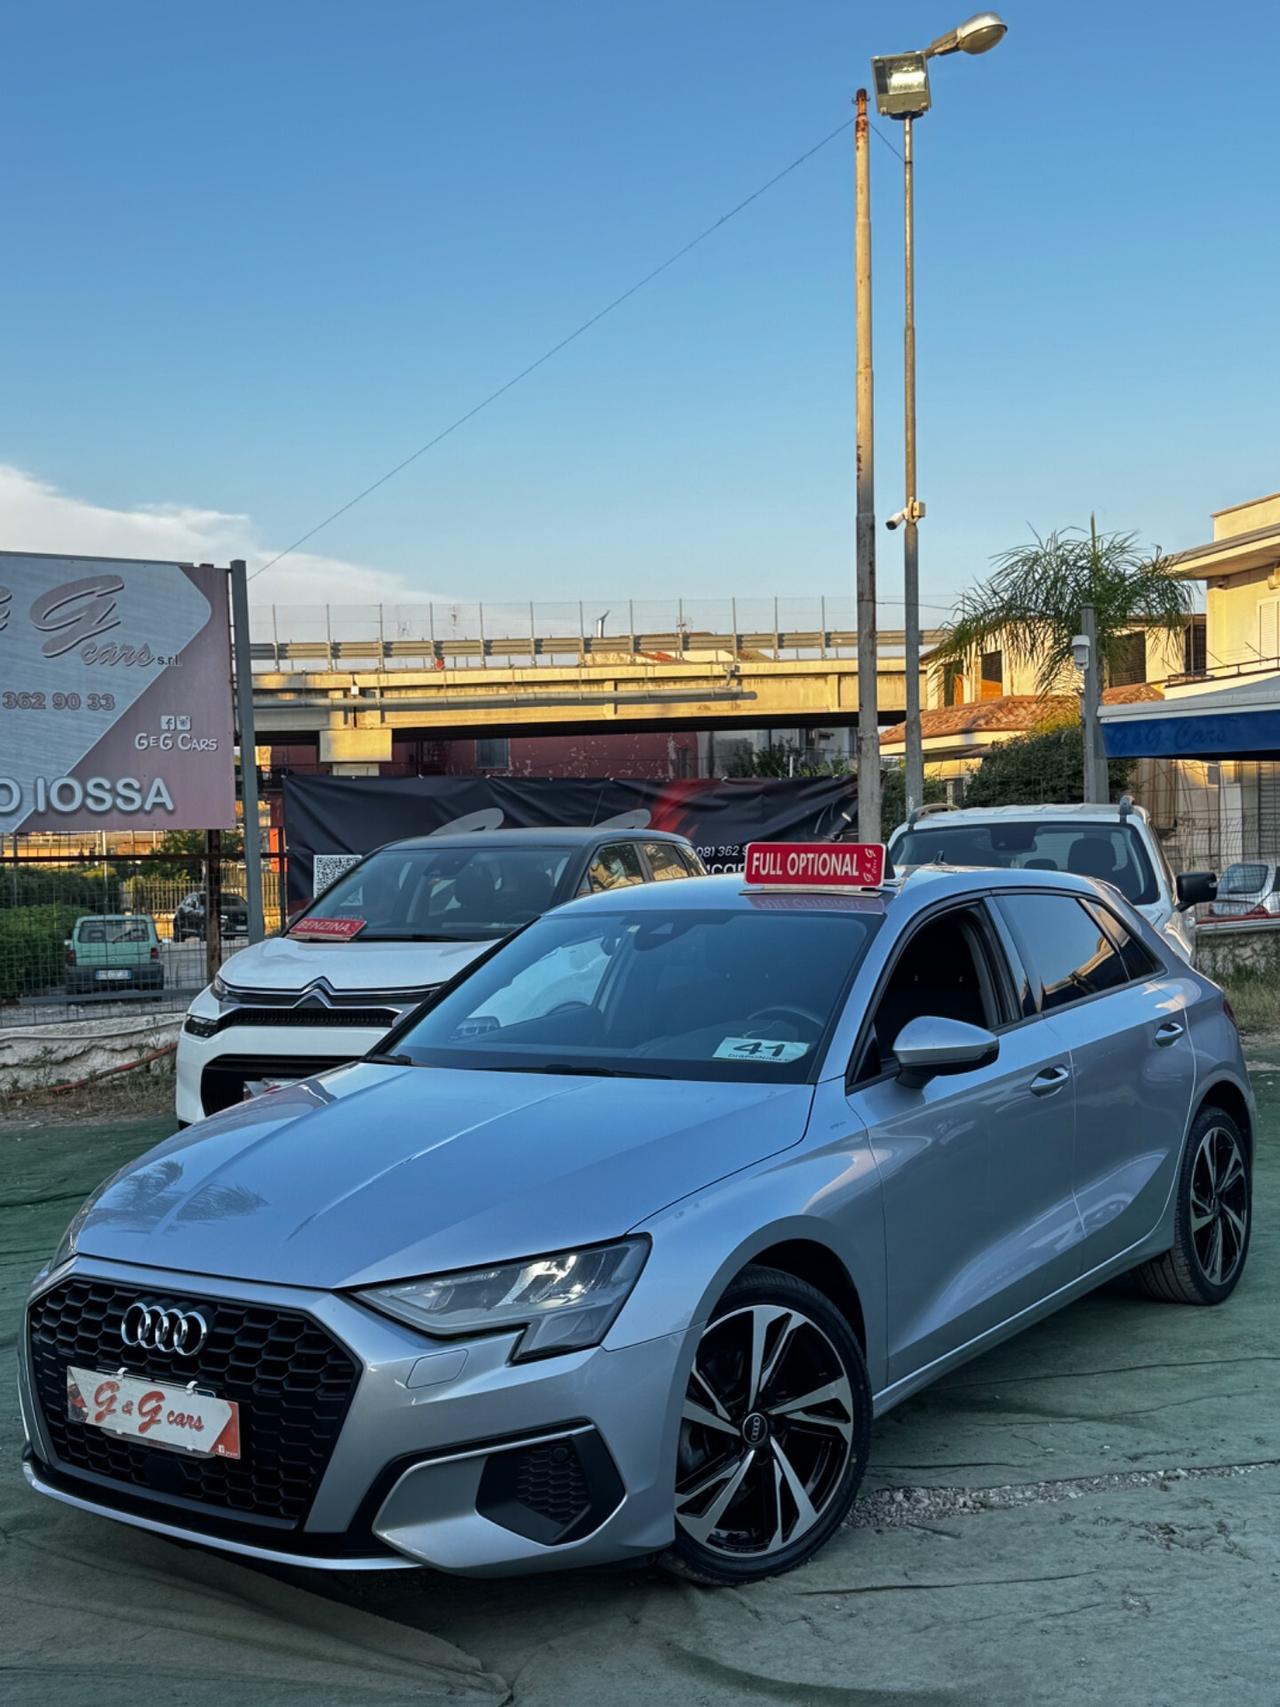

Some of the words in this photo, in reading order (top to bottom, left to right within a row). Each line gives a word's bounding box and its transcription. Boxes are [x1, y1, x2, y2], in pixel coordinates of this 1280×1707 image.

[30, 574, 125, 658] G
[80, 641, 155, 668] cars
[2, 691, 46, 710] 362
[52, 692, 81, 710] 90
[87, 693, 115, 711] 33
[36, 777, 174, 813] IOSSA
[717, 845, 739, 857] 362
[751, 852, 783, 876] FULL
[786, 852, 859, 877] OPTIONAL
[296, 920, 350, 932] BENZINA
[732, 1041, 785, 1057] 41
[94, 1380, 120, 1424] G
[121, 1400, 134, 1417] &
[137, 1390, 165, 1434] G
[167, 1410, 204, 1432] cars
